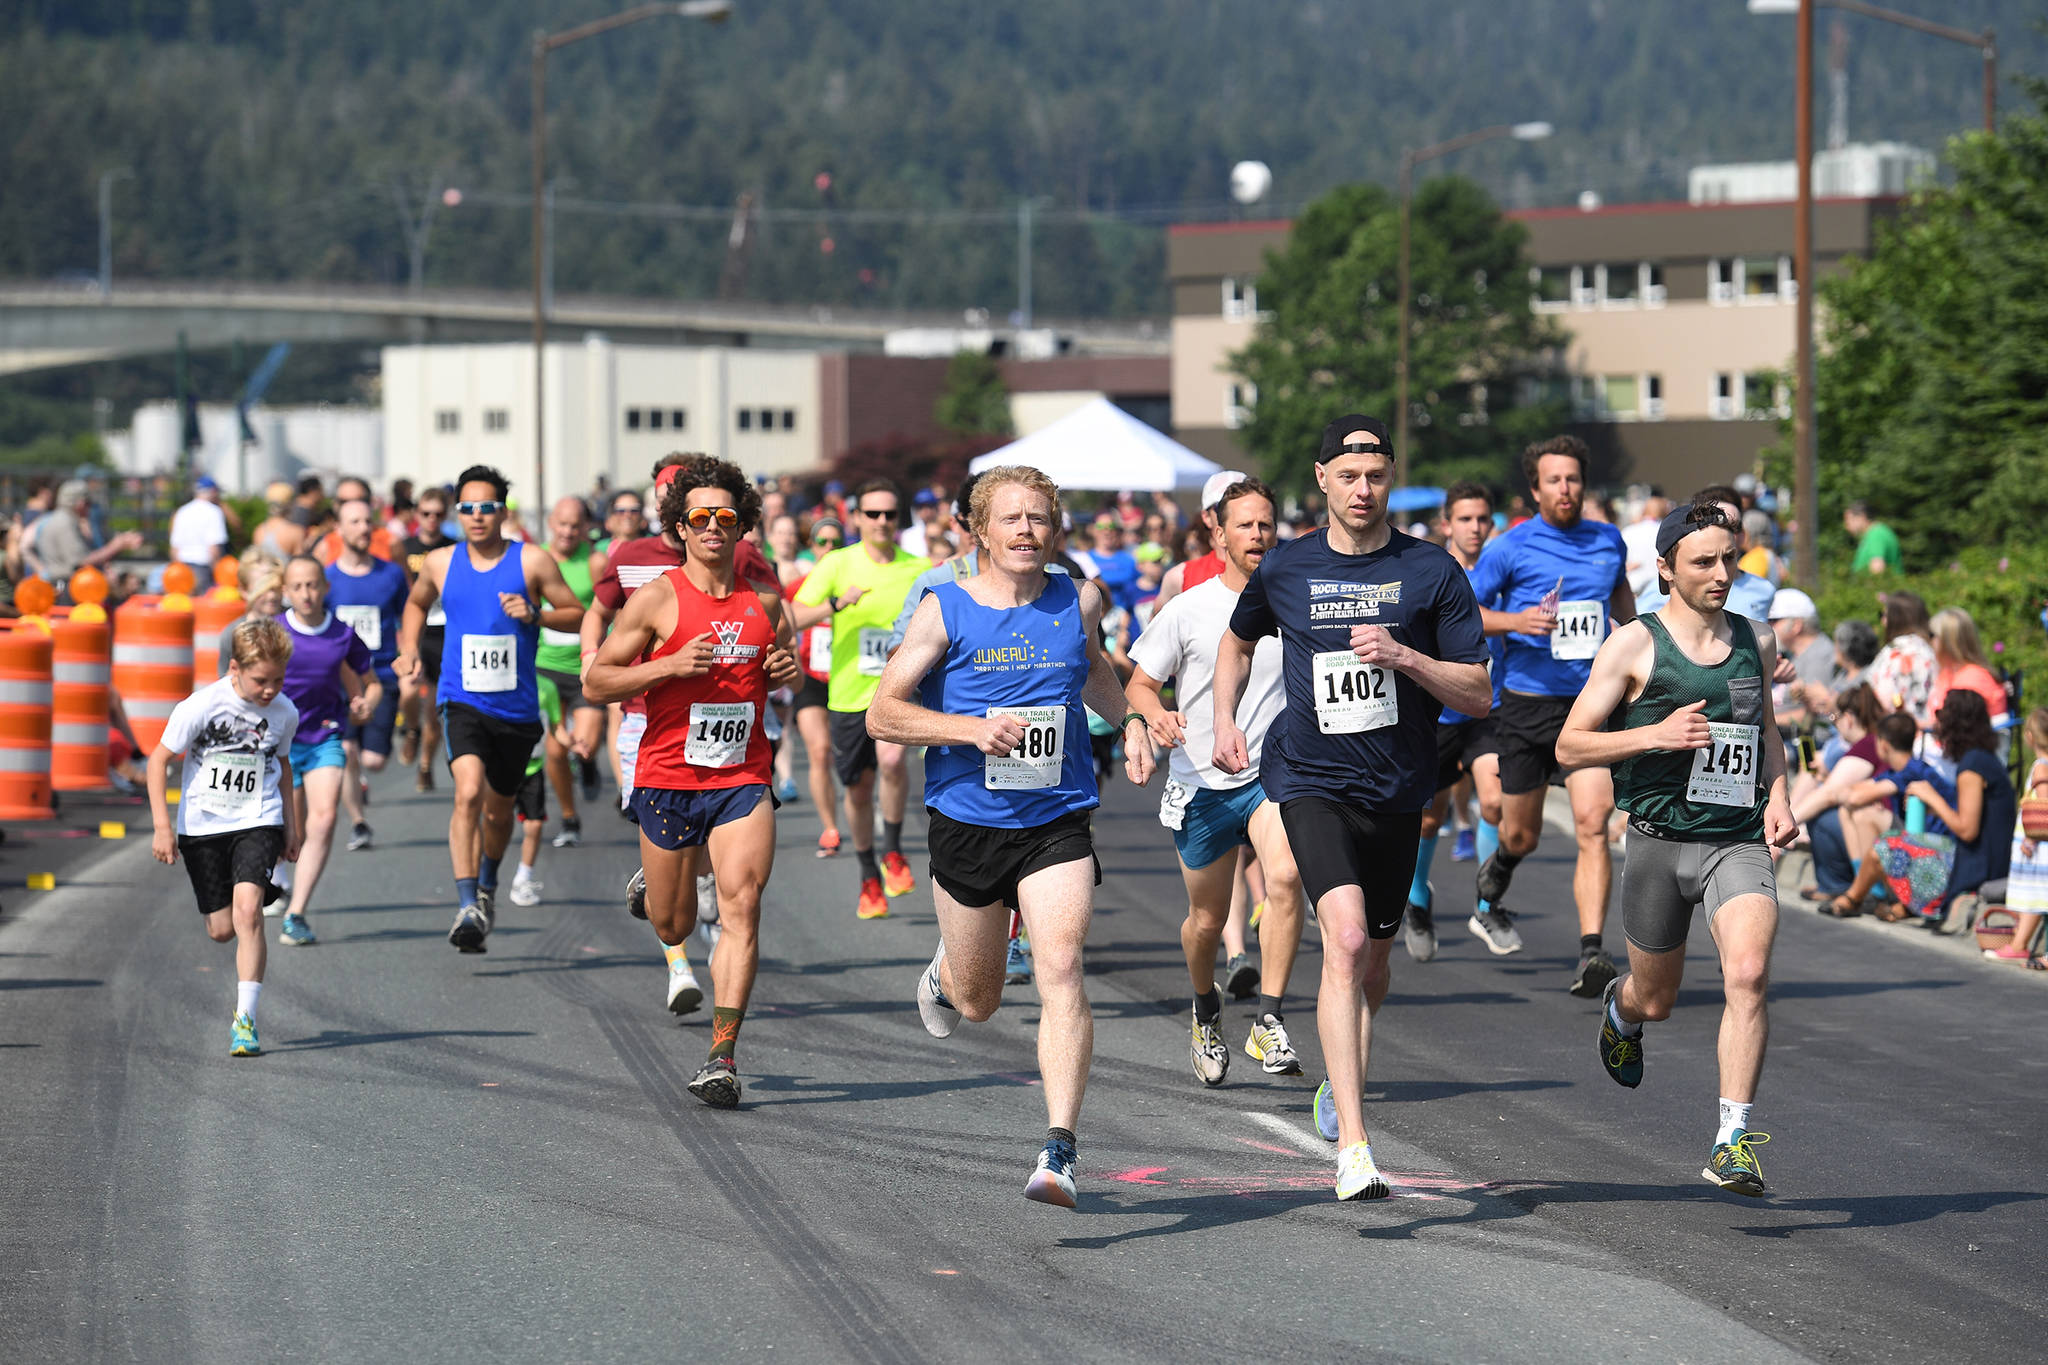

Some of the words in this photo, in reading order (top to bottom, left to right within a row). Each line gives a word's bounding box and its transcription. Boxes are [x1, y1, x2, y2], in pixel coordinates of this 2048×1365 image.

[1310, 584, 1339, 595] ROCK
[1340, 584, 1379, 593] STEADY
[1310, 601, 1379, 614] JUNEAU
[1560, 616, 1598, 637] 1447
[471, 650, 509, 669] 1484
[973, 647, 1028, 663] JUNEAU
[1033, 661, 1066, 669] MARATHON
[1325, 668, 1387, 704] 1402
[696, 720, 748, 743] 1468
[997, 727, 1056, 758] 480
[1702, 743, 1752, 776] 1453
[209, 767, 256, 793] 1446
